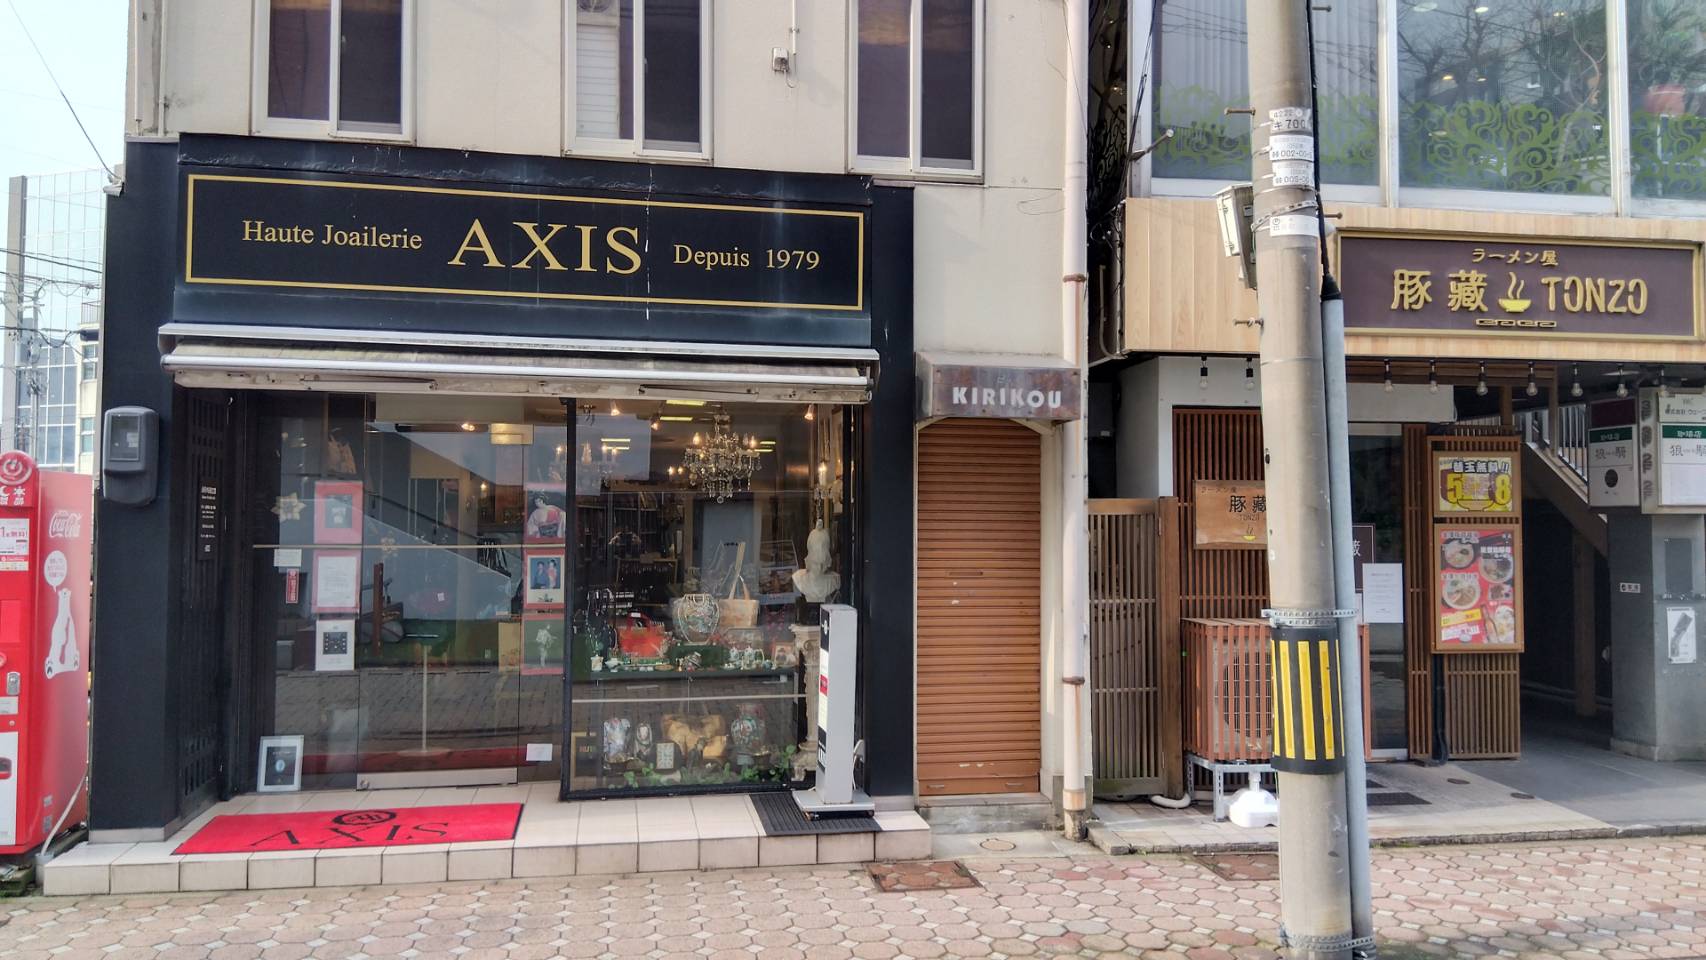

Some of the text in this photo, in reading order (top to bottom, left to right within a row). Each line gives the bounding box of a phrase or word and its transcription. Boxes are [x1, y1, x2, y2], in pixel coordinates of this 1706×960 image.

[242, 218, 821, 276] Haute Joailerie AXIS Depuis 1979
[1471, 247, 1559, 267] ラーメン屋
[1541, 275, 1649, 316] TONZO
[952, 386, 1062, 409] KIRIKOU
[250, 822, 449, 847] AXIS
